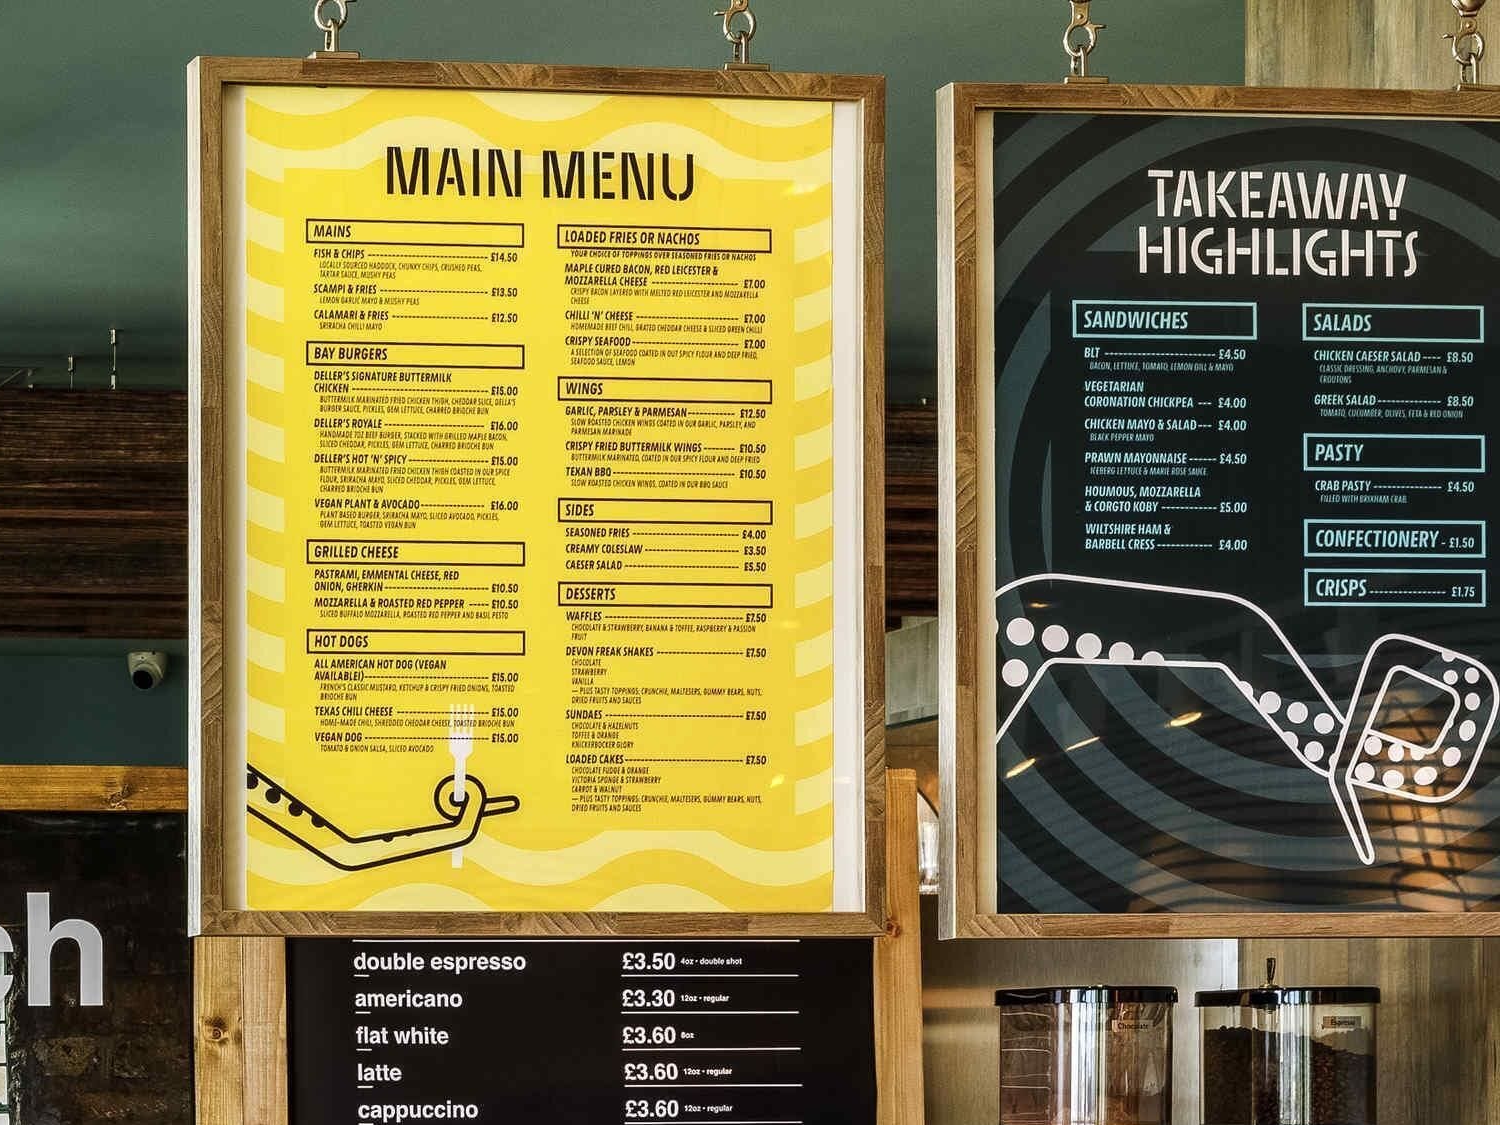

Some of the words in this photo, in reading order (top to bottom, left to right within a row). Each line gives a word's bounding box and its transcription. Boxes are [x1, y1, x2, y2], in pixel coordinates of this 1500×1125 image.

[387, 146, 521, 197] MAIN
[543, 150, 694, 201] MENU
[1148, 170, 1407, 220] TAKEAWAY
[313, 226, 351, 238] MAINS
[565, 231, 606, 244] LOADED
[609, 231, 637, 244] FRIES
[640, 232, 655, 244] OR
[657, 232, 700, 245] NACHOS
[314, 248, 331, 258] FISH
[333, 249, 339, 258] &
[341, 249, 364, 259] CHIPS
[491, 252, 518, 262] £14.50
[1139, 226, 1418, 277] HIGHLIGHTS
[314, 284, 345, 294] SCAMPI
[347, 284, 354, 294] &
[355, 284, 377, 294] FRIES
[491, 287, 518, 297] £13.50
[1084, 310, 1188, 329] SANDWICHES
[1314, 313, 1372, 332] SALADS
[565, 336, 593, 346] CRISPY
[595, 336, 631, 347] SEAFOOD
[744, 339, 765, 349] £7.00
[314, 347, 335, 360] BAY
[338, 347, 387, 360] BURGERS
[1084, 347, 1100, 358] BLT
[1219, 349, 1246, 360] £4.50
[566, 382, 603, 395] WINGS
[1085, 381, 1144, 392] VEGETARIAN
[1084, 396, 1146, 407] CORONATION
[1148, 396, 1193, 408] CHICKPEA
[1218, 397, 1246, 408] £4.00
[1314, 394, 1344, 405] GREEK
[1346, 394, 1376, 405] SALAD
[1447, 396, 1474, 407] £8.50
[314, 418, 350, 428] DELLER'S
[352, 419, 382, 429] ROYALE
[490, 421, 518, 431] £16.00
[1085, 452, 1121, 463] PRAWN
[1123, 452, 1187, 464] MAYONNAISE
[1220, 453, 1247, 464] £4.50
[1315, 444, 1364, 461] PASTY
[566, 466, 593, 476] TEXAN
[595, 467, 611, 477] BBQ
[739, 469, 766, 479] £10.50
[1315, 480, 1340, 491] CRAB
[1342, 480, 1371, 491] PASTY
[1447, 481, 1474, 492] £4.50
[566, 504, 594, 516] SIDES
[1316, 530, 1439, 548] CONFECTIONERY
[1449, 537, 1474, 548] £1.50
[315, 545, 358, 558] GRILLED
[361, 546, 399, 559] CHEESE
[566, 587, 615, 600] DESSERTS
[1316, 579, 1367, 597] CRISPS
[1452, 586, 1475, 597] £1.75
[566, 611, 602, 621] WAFFLES
[746, 613, 766, 623] £7.50
[315, 635, 337, 647] HOT
[339, 635, 368, 648] DOGS
[571, 658, 601, 667] CHOCOLATE
[572, 668, 607, 676] STRAWBERRY
[572, 677, 593, 685] VANILLA
[566, 709, 602, 719] SUNDAES
[746, 711, 766, 720] £7.50
[315, 732, 343, 742] VEGAN
[345, 732, 362, 742] DOG
[492, 733, 519, 743] £15.00
[566, 754, 597, 764] LOADED
[599, 754, 624, 764] CAKES
[746, 755, 767, 765] £7.50
[354, 952, 424, 970] double
[430, 956, 526, 974] espresso
[622, 952, 675, 970] £3.50
[699, 957, 725, 965] double
[726, 957, 742, 965] shot
[355, 989, 463, 1007] americano
[622, 989, 675, 1007] £3.30
[681, 994, 697, 1002] 12oz
[703, 994, 729, 1003] regular
[356, 1026, 388, 1044] flat
[394, 1027, 449, 1045] white
[623, 1026, 676, 1044] £3.60
[358, 1063, 402, 1081] latte
[624, 1063, 678, 1080] £3.60
[358, 1100, 478, 1123] cappuccino
[625, 1100, 679, 1118] £3.60
